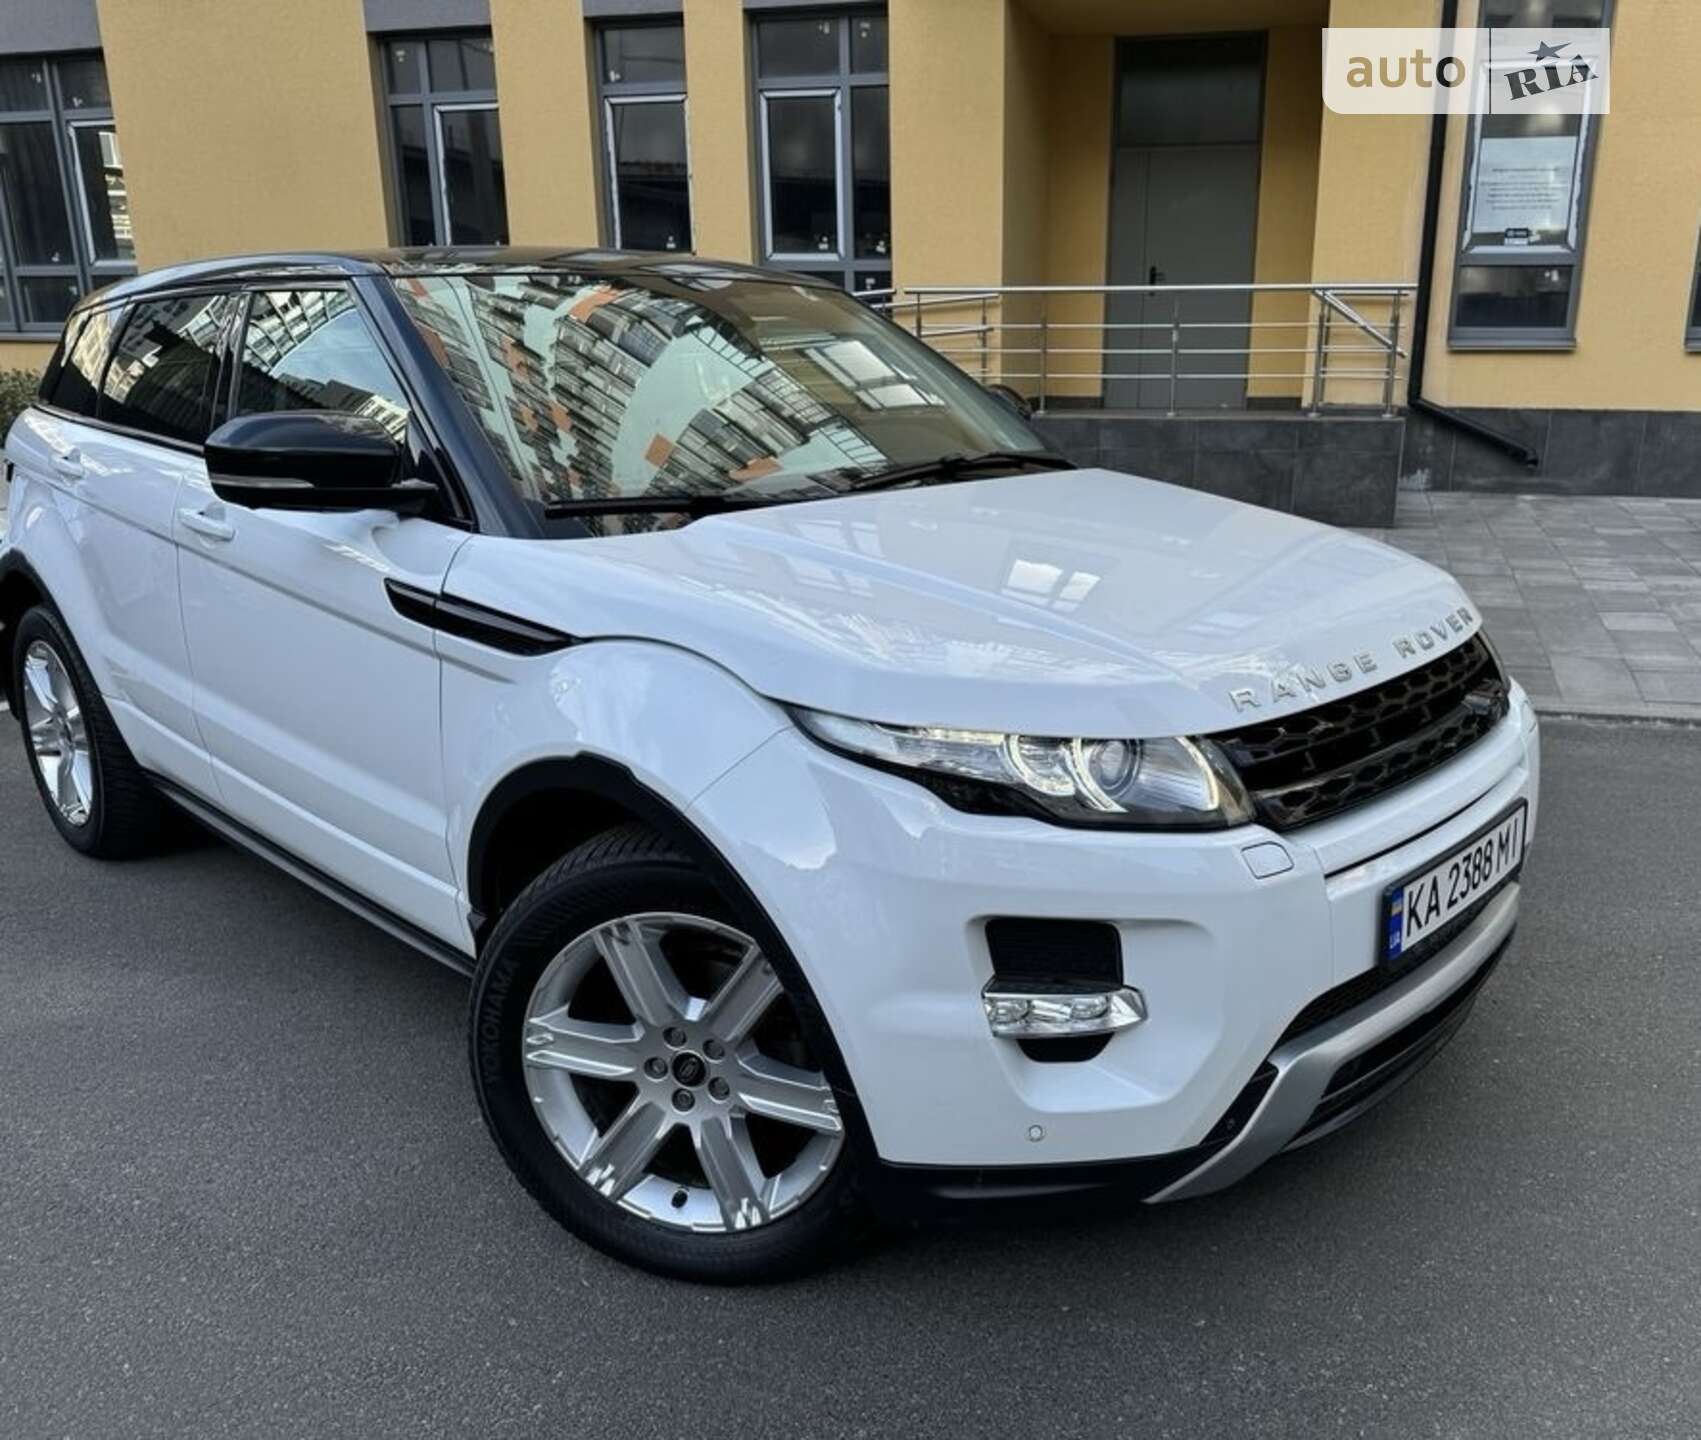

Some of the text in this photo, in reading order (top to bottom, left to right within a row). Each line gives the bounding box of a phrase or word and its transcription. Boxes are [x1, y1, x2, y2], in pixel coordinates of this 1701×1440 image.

[1228, 607, 1474, 712] RANGE ROVER
[1406, 818, 1519, 937] KA 2388 MI
[480, 958, 518, 1085] YOKOHAMA
